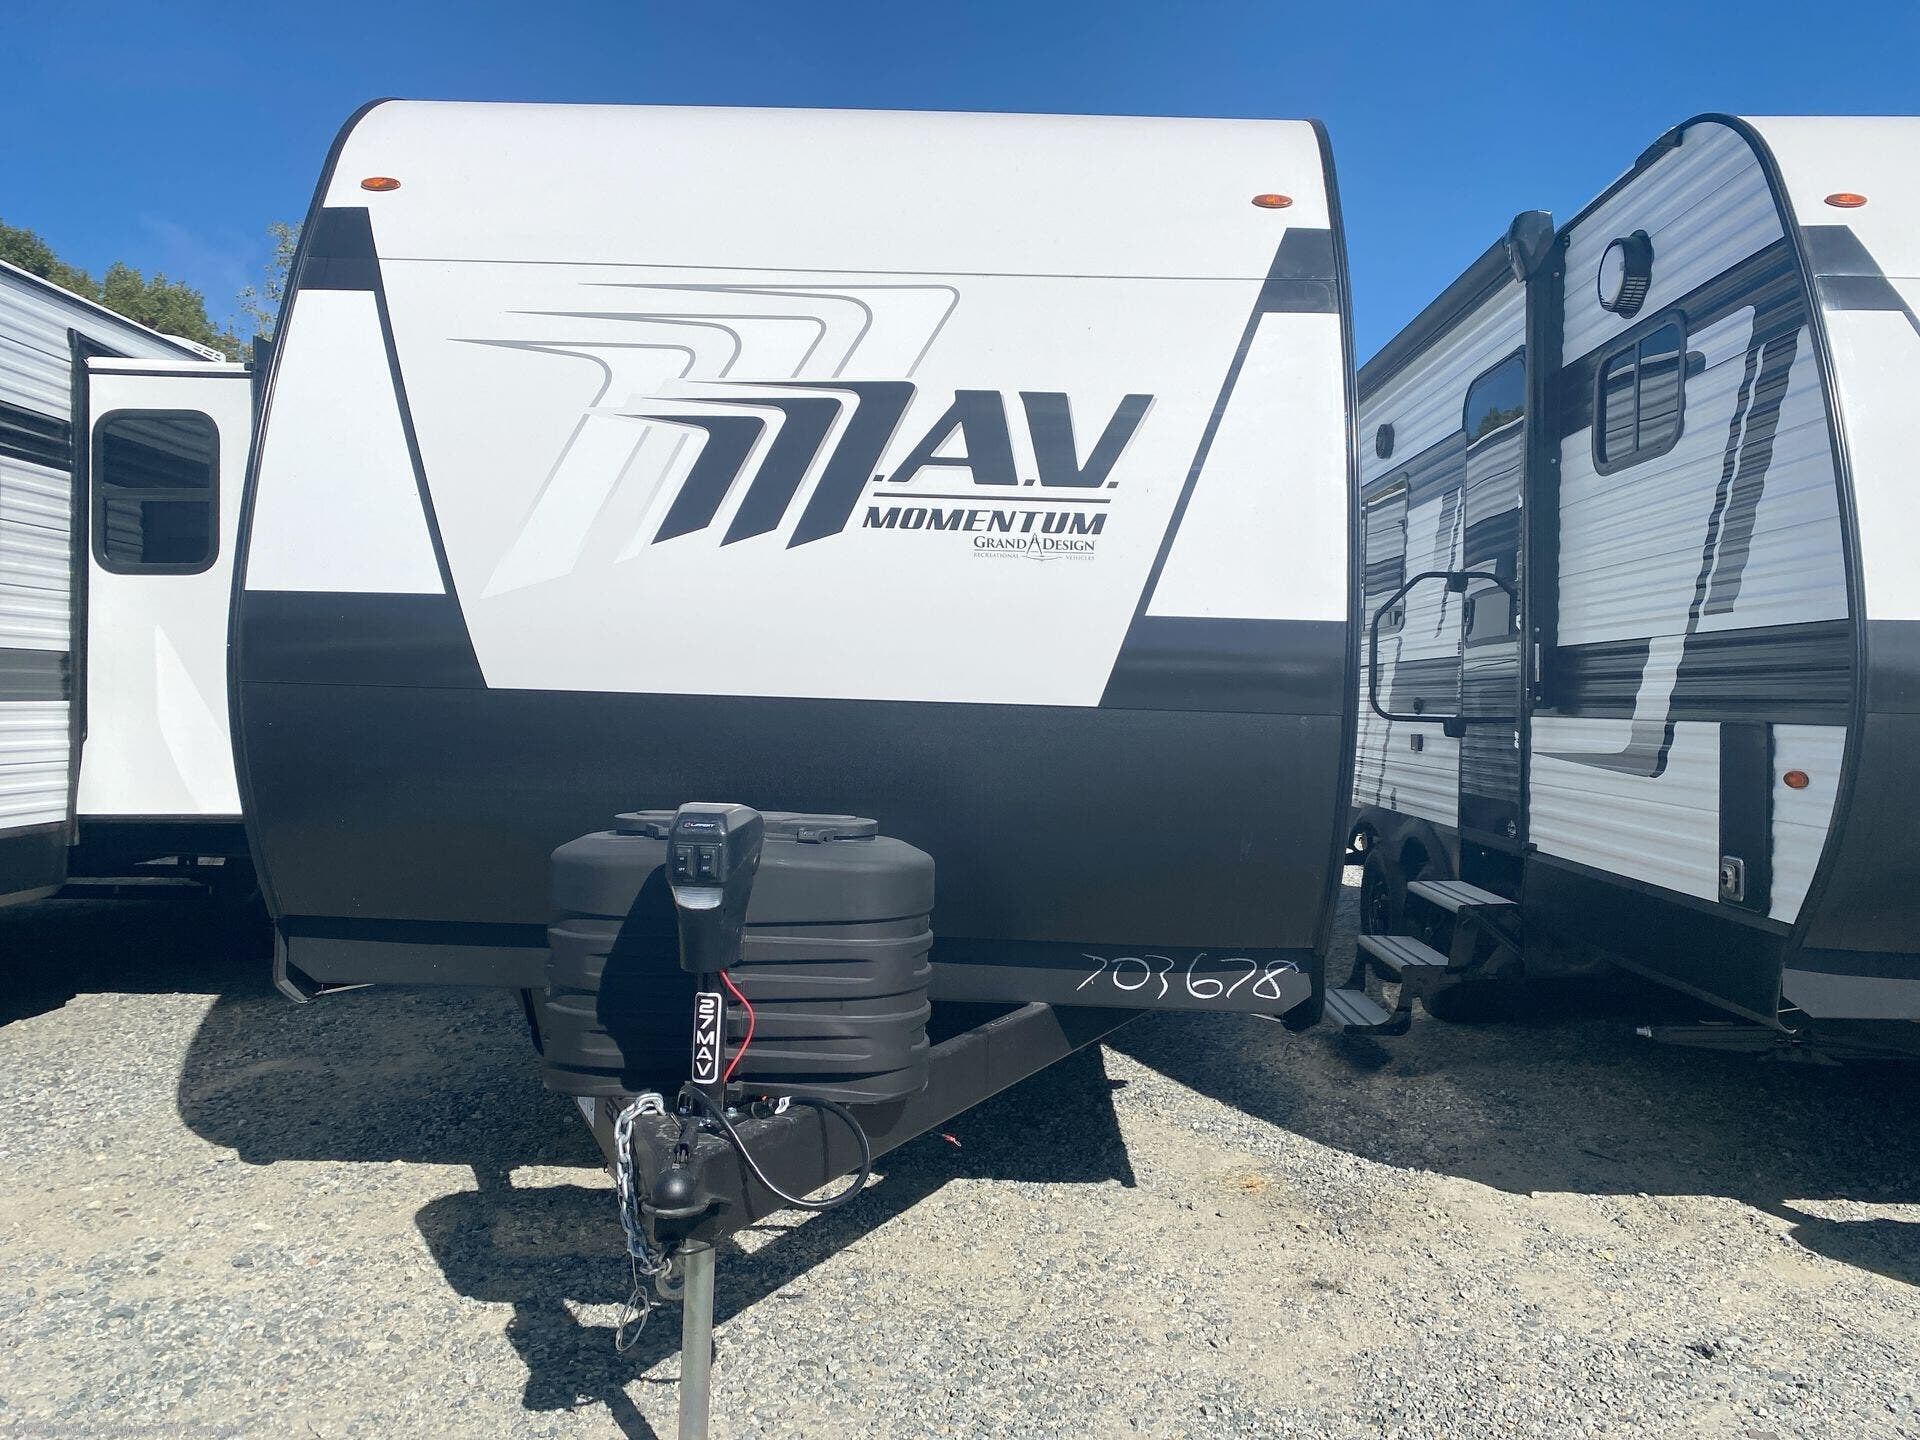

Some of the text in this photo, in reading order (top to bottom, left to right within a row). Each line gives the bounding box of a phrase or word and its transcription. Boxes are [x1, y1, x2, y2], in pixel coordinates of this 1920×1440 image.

[863, 506, 1108, 535] MOMENTUM
[974, 536, 1096, 552] GRAND DESIGN
[1076, 952, 1300, 1000] 703678
